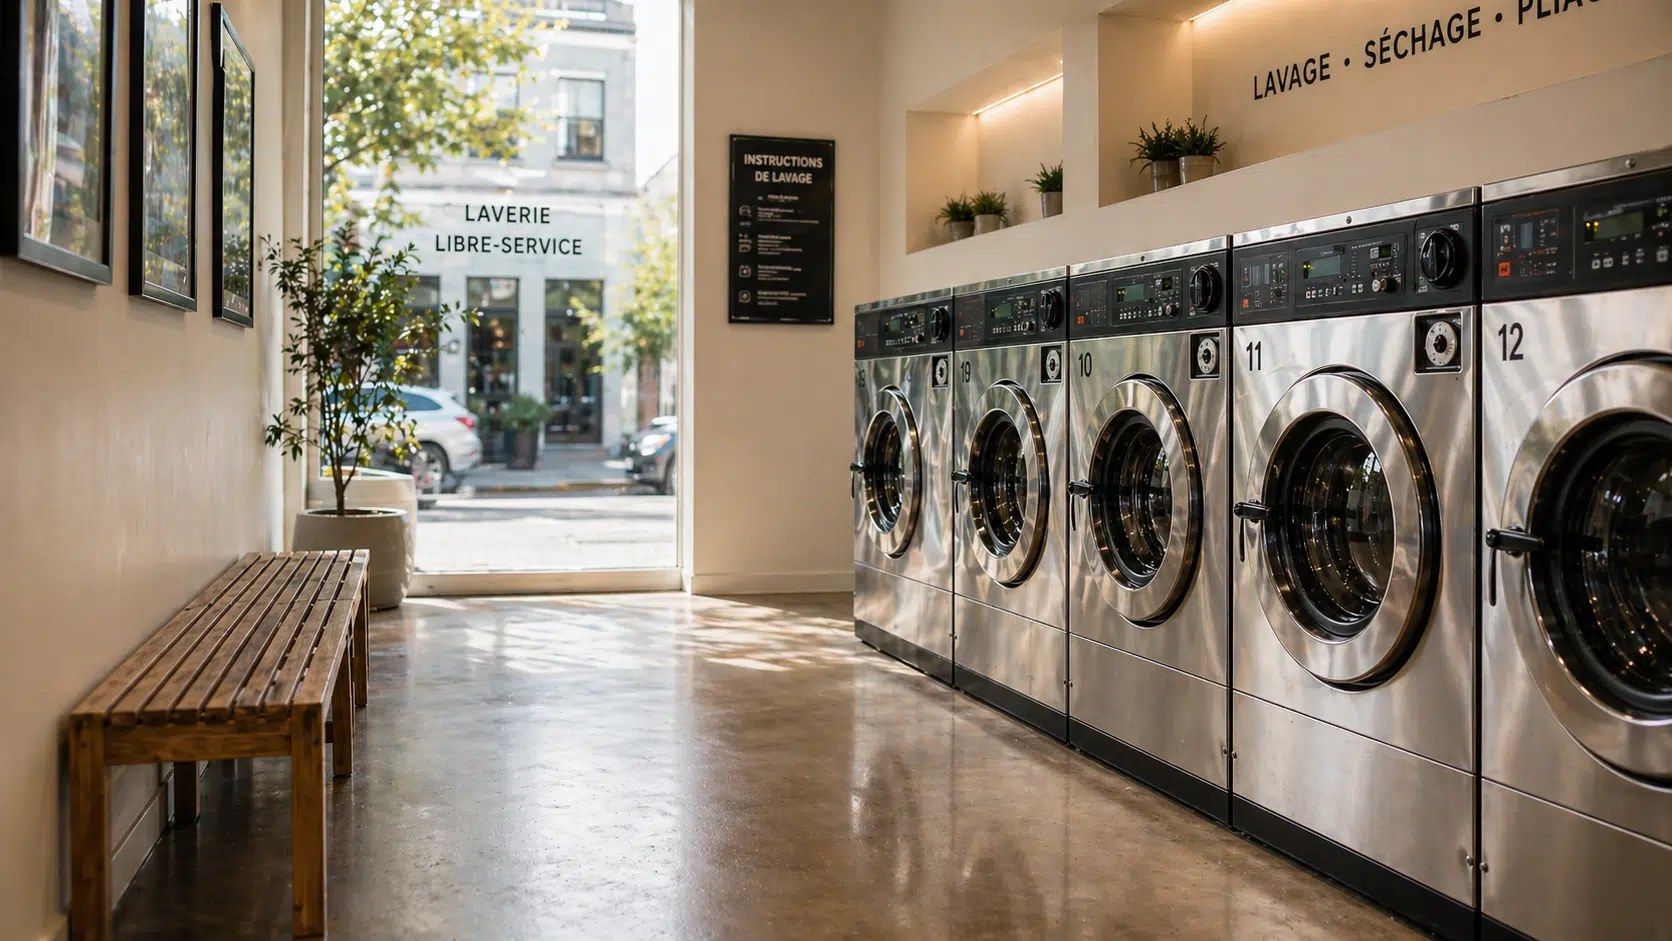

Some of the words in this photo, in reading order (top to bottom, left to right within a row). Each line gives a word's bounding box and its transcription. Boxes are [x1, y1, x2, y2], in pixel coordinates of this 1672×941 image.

[1253, 53, 1331, 101] LAVAGE
[1364, 5, 1482, 69] SÉCHAGE
[744, 153, 823, 169] INSTRUCTIONS
[755, 171, 769, 182] DE
[772, 173, 813, 185] LAVAGE
[465, 204, 550, 224] LAVERIE
[436, 234, 582, 255] LIBRE-SERVICE
[1498, 322, 1524, 361] 12
[1078, 352, 1093, 378] 10
[1246, 341, 1262, 372] 11
[960, 360, 971, 383] 19
